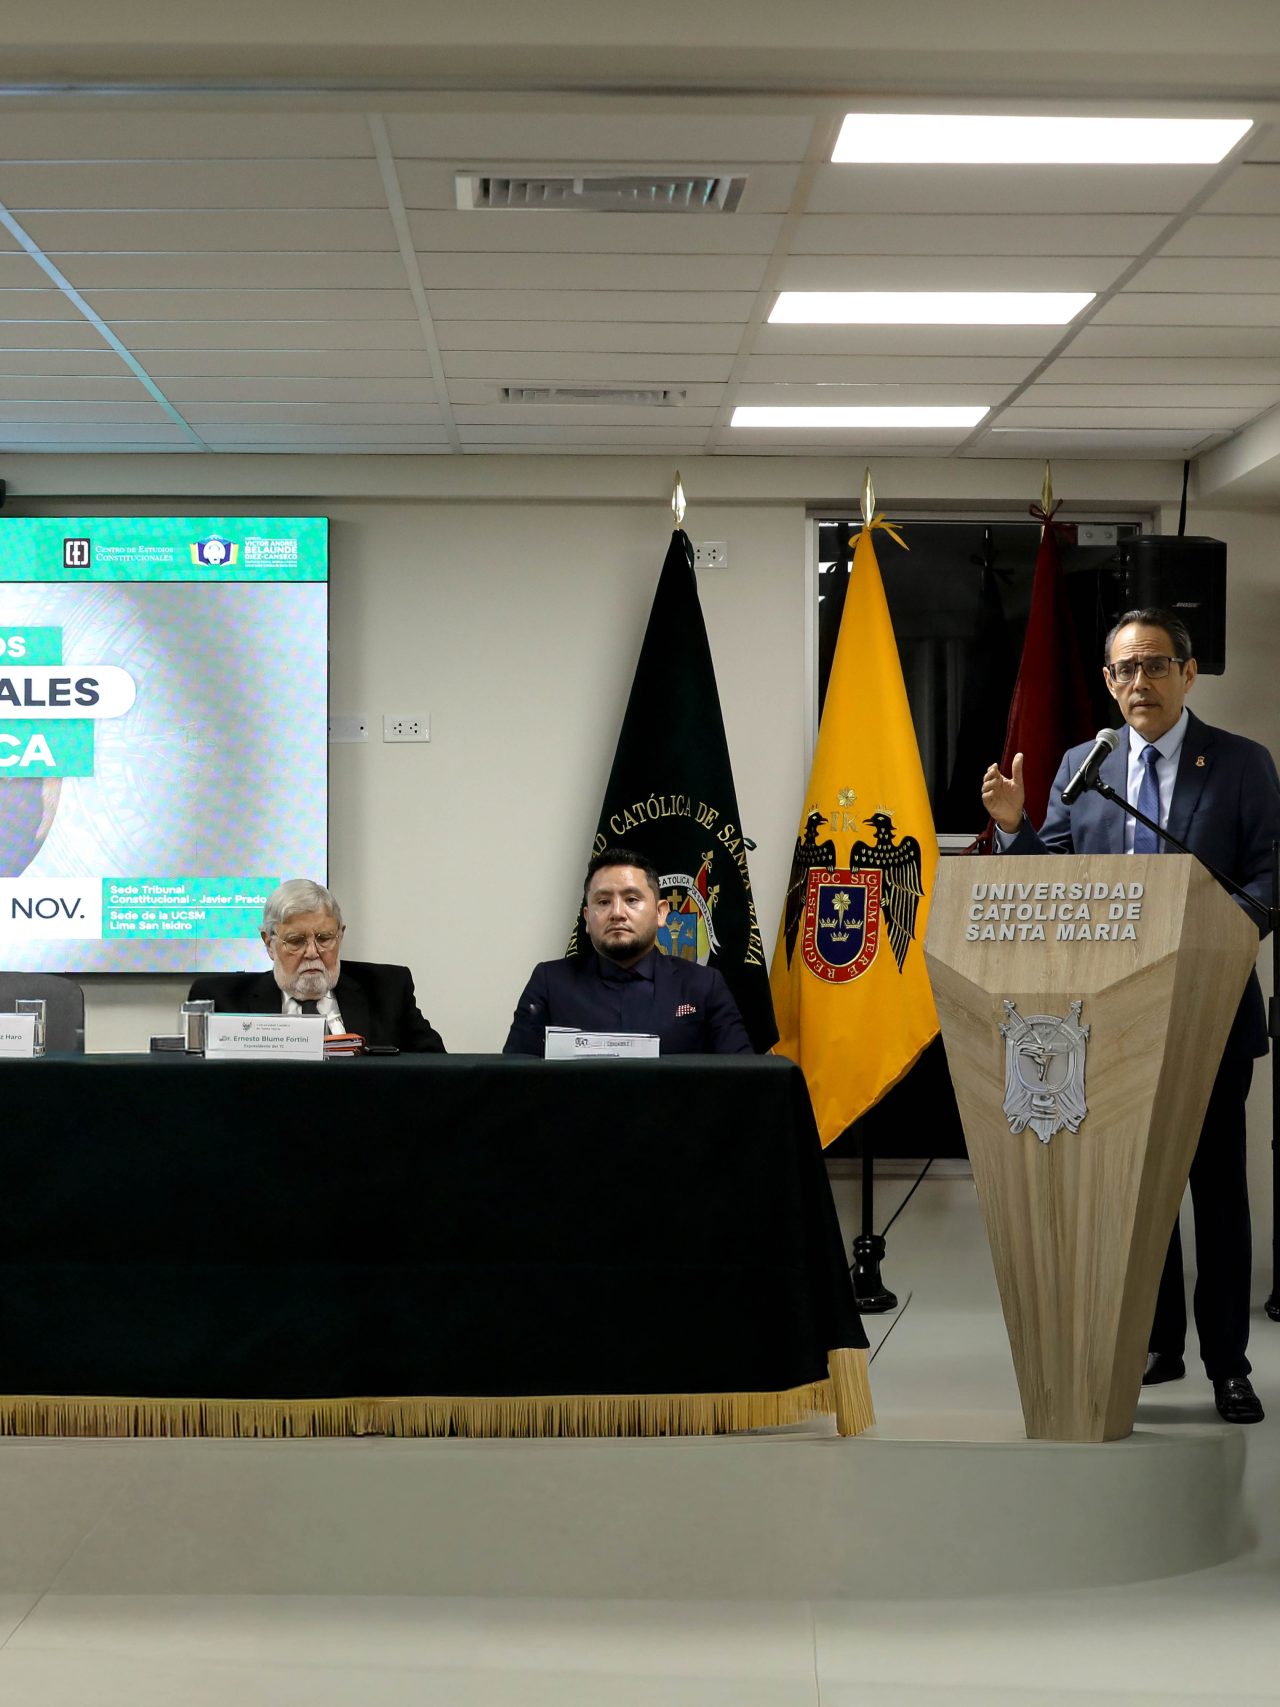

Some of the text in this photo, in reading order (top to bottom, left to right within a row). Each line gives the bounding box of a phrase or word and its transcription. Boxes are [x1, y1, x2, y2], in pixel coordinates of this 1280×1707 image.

[244, 546, 298, 554] BELAUNDE
[610, 793, 691, 835] CATÓLICA
[695, 801, 720, 830] DE
[811, 872, 841, 884] HOC
[110, 885, 185, 894] Sede Tribunal
[971, 882, 1145, 901] UNIVERSIDAD
[110, 894, 190, 904] Constitucional
[199, 894, 232, 904] Javier
[235, 894, 268, 904] Prado
[12, 897, 86, 919] NOV.
[968, 902, 1143, 921] CATOLICA DE
[110, 911, 206, 920] Sede de la UCSM
[110, 921, 192, 930] Lima San Isidro
[965, 923, 1137, 941] SANTA MARIA
